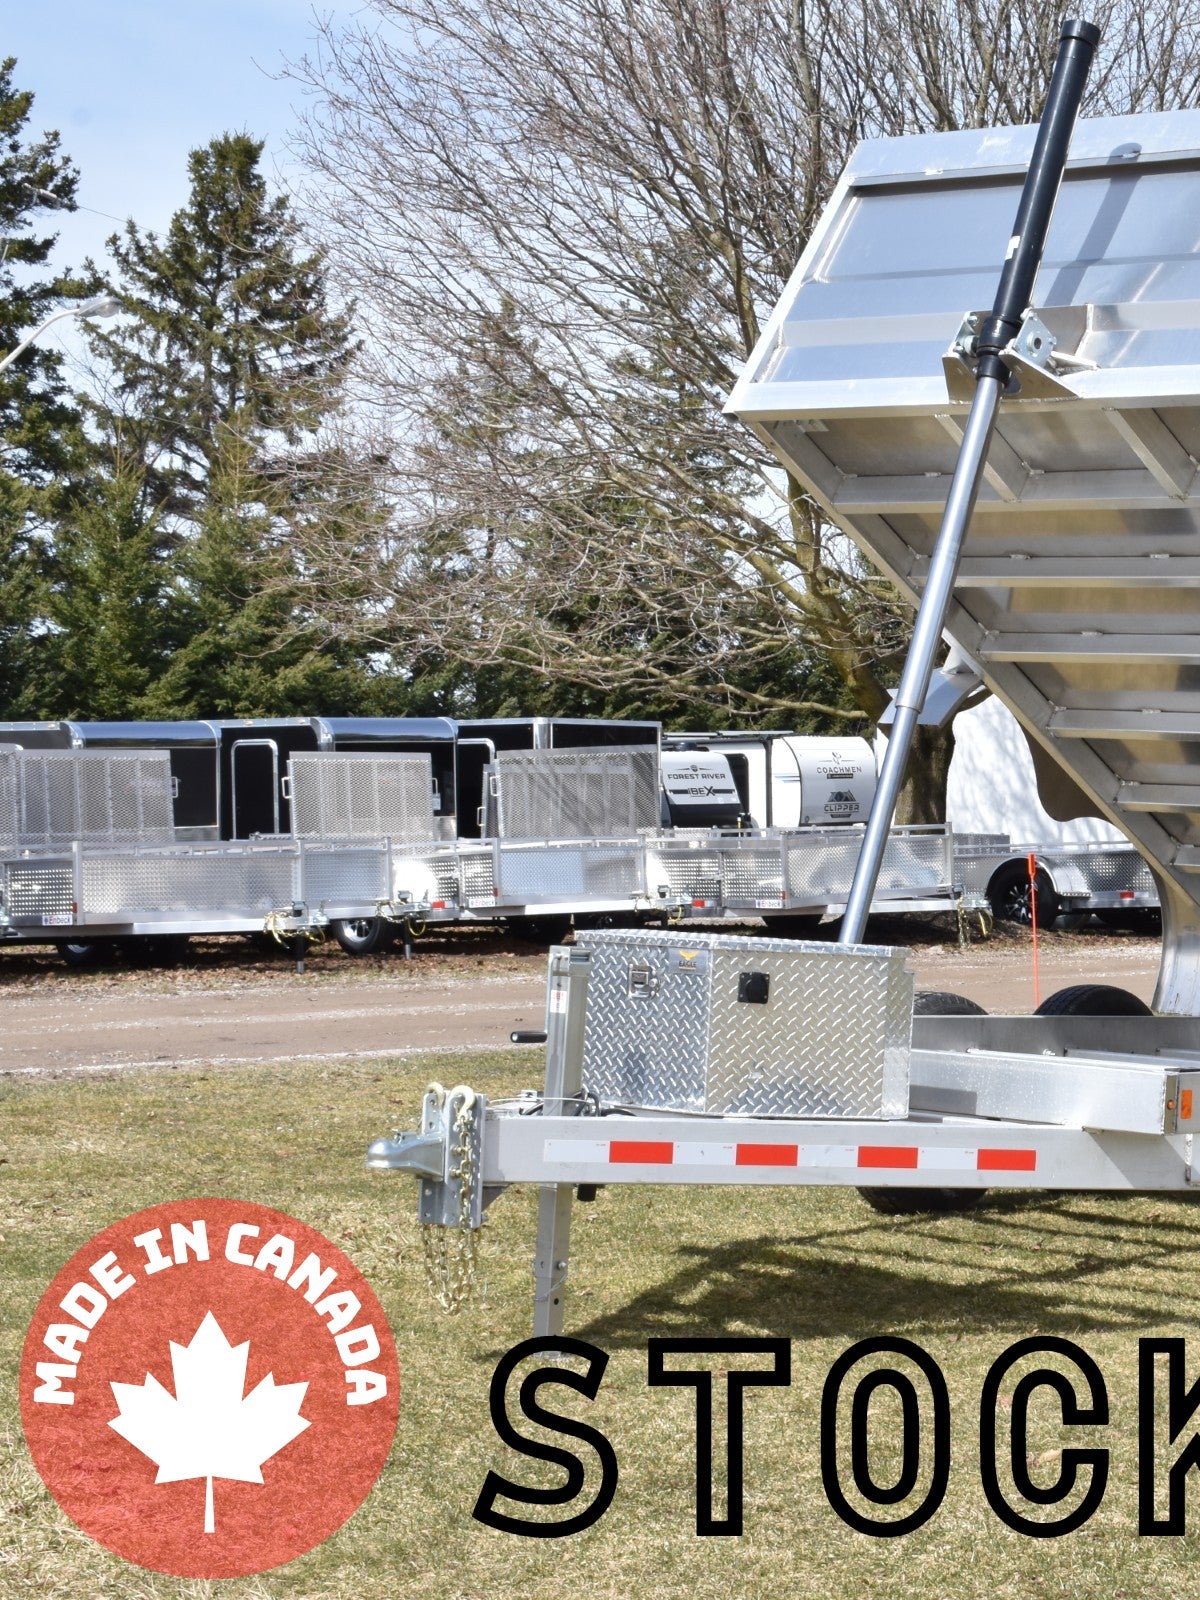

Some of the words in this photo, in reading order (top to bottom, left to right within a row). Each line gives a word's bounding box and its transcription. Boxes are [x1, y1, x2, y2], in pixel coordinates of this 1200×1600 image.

[816, 766, 862, 774] COACHMEN
[688, 786, 716, 797] IBEX
[824, 804, 860, 812] CLIPPER
